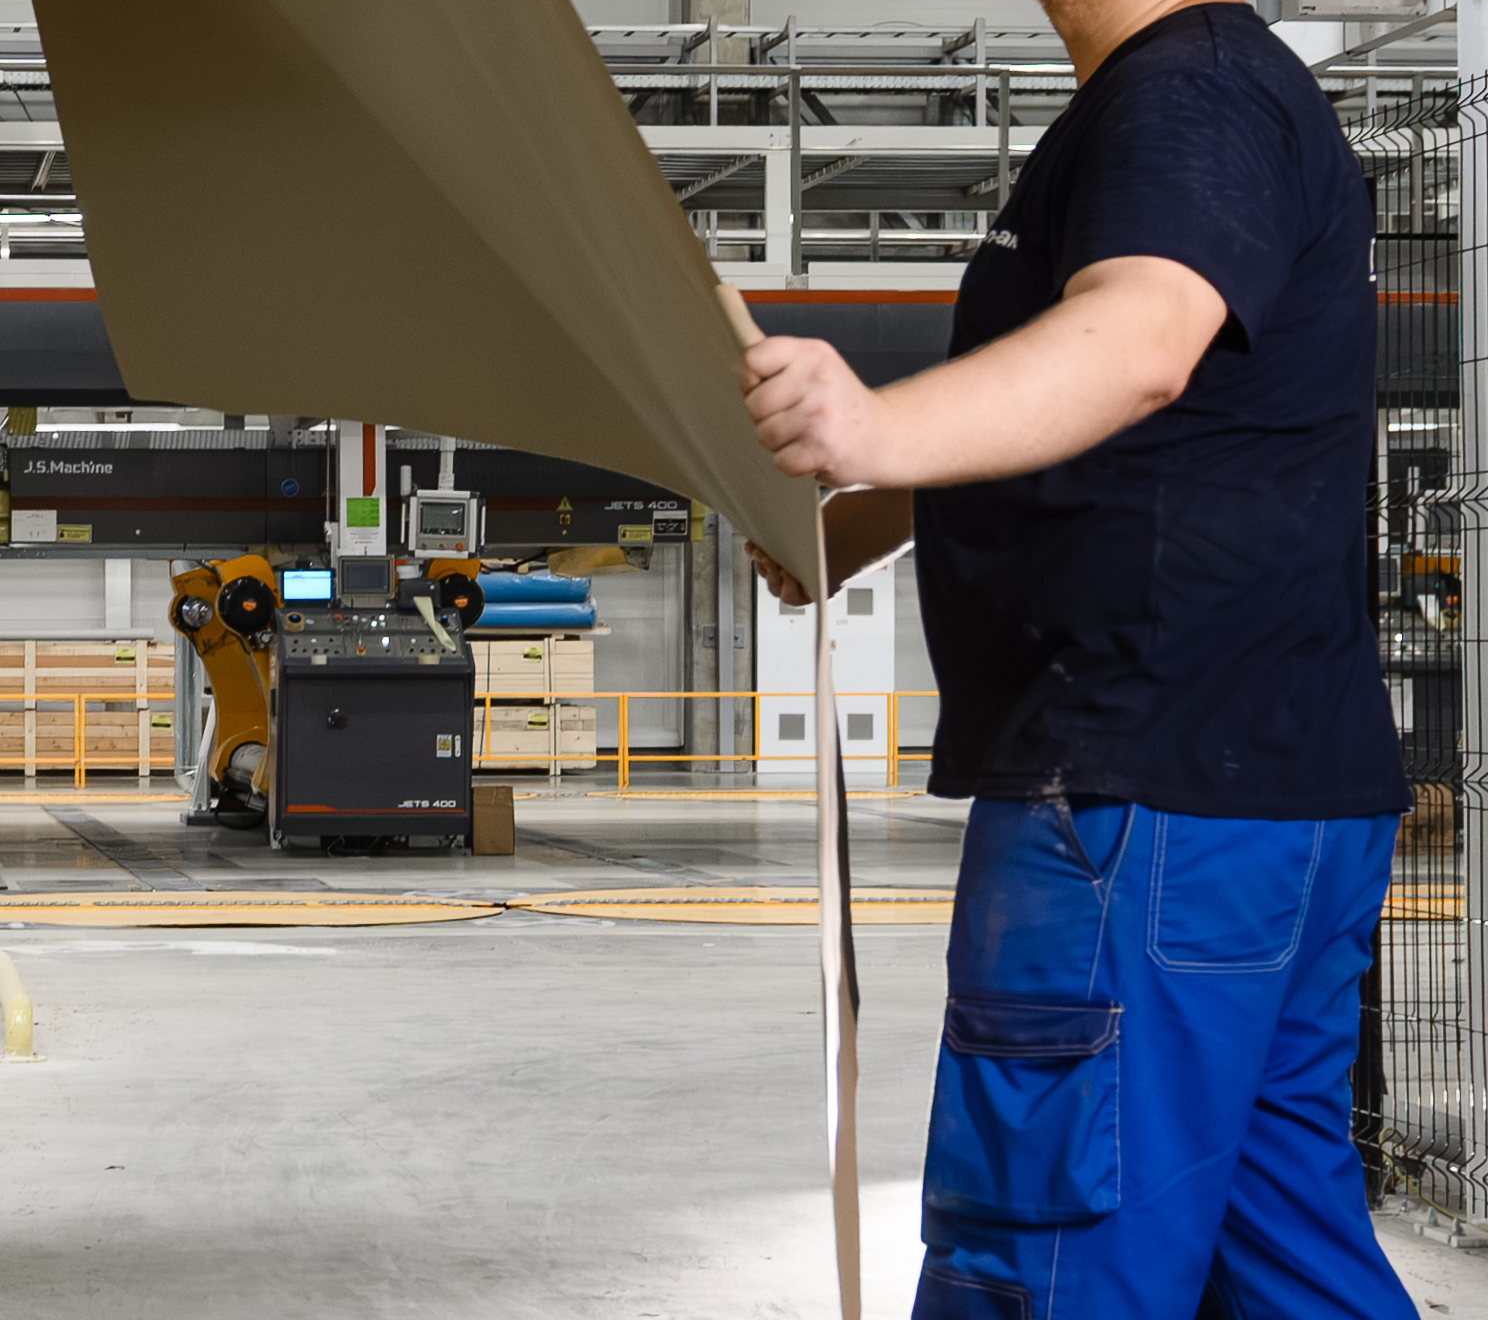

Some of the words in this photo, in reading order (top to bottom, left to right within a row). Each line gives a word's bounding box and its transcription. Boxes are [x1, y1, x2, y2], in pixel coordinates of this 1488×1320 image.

[24, 461, 113, 474] J.S.Machine
[604, 501, 644, 510] JETS
[648, 501, 678, 510] 400
[398, 800, 430, 808] JETS
[433, 800, 457, 808] 400
